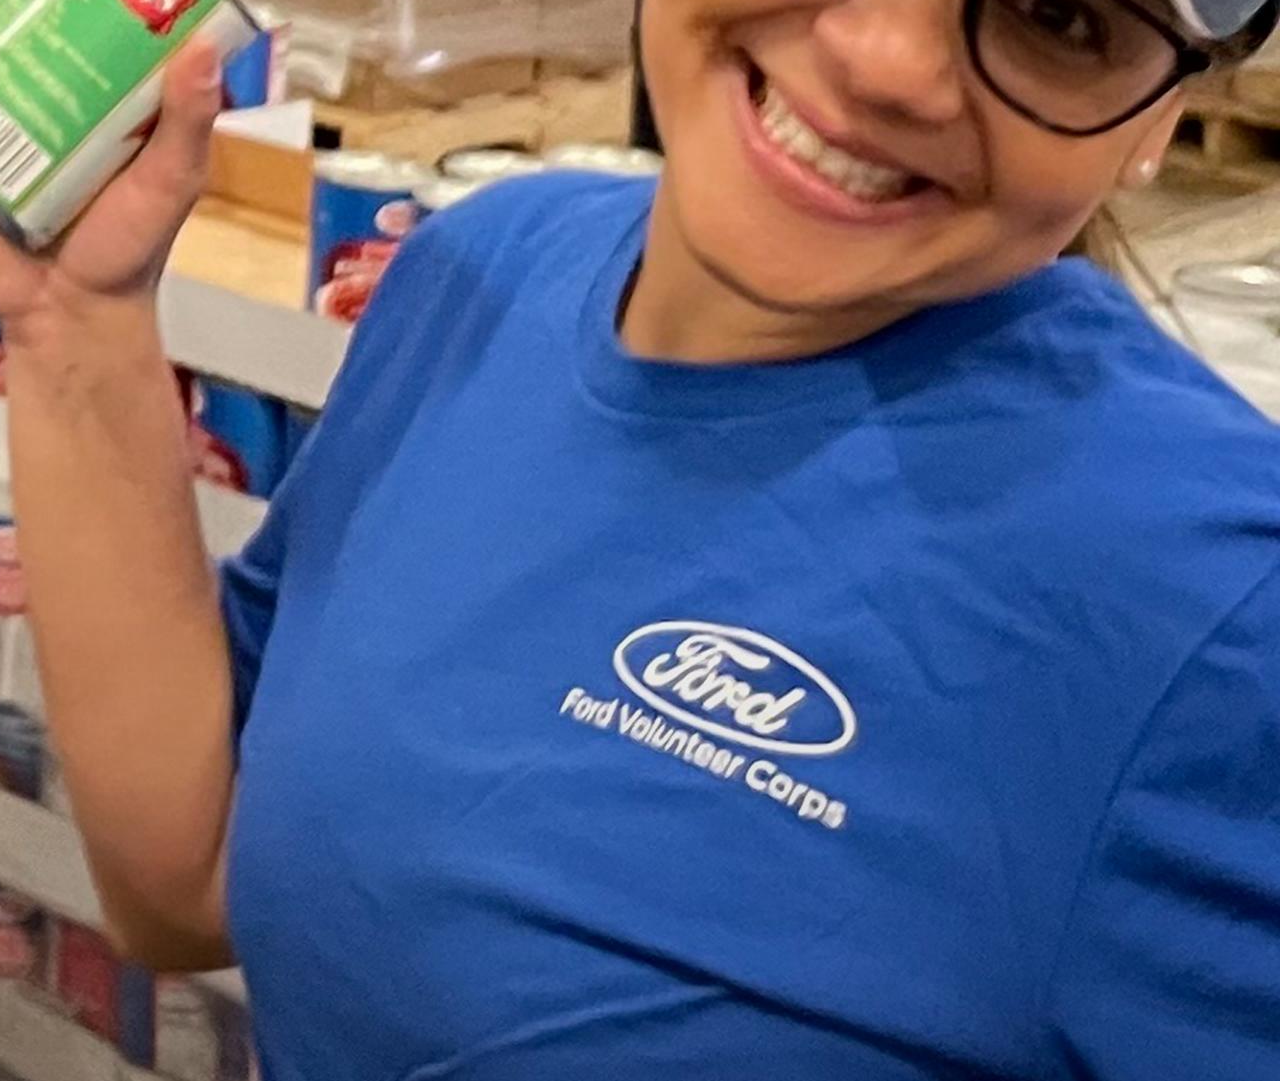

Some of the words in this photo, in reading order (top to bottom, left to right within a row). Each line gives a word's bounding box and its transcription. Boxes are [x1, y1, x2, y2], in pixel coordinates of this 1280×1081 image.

[643, 634, 807, 735] Ford
[559, 687, 618, 729] Ford
[619, 703, 745, 779] Volunteer
[745, 759, 847, 829] Corps
